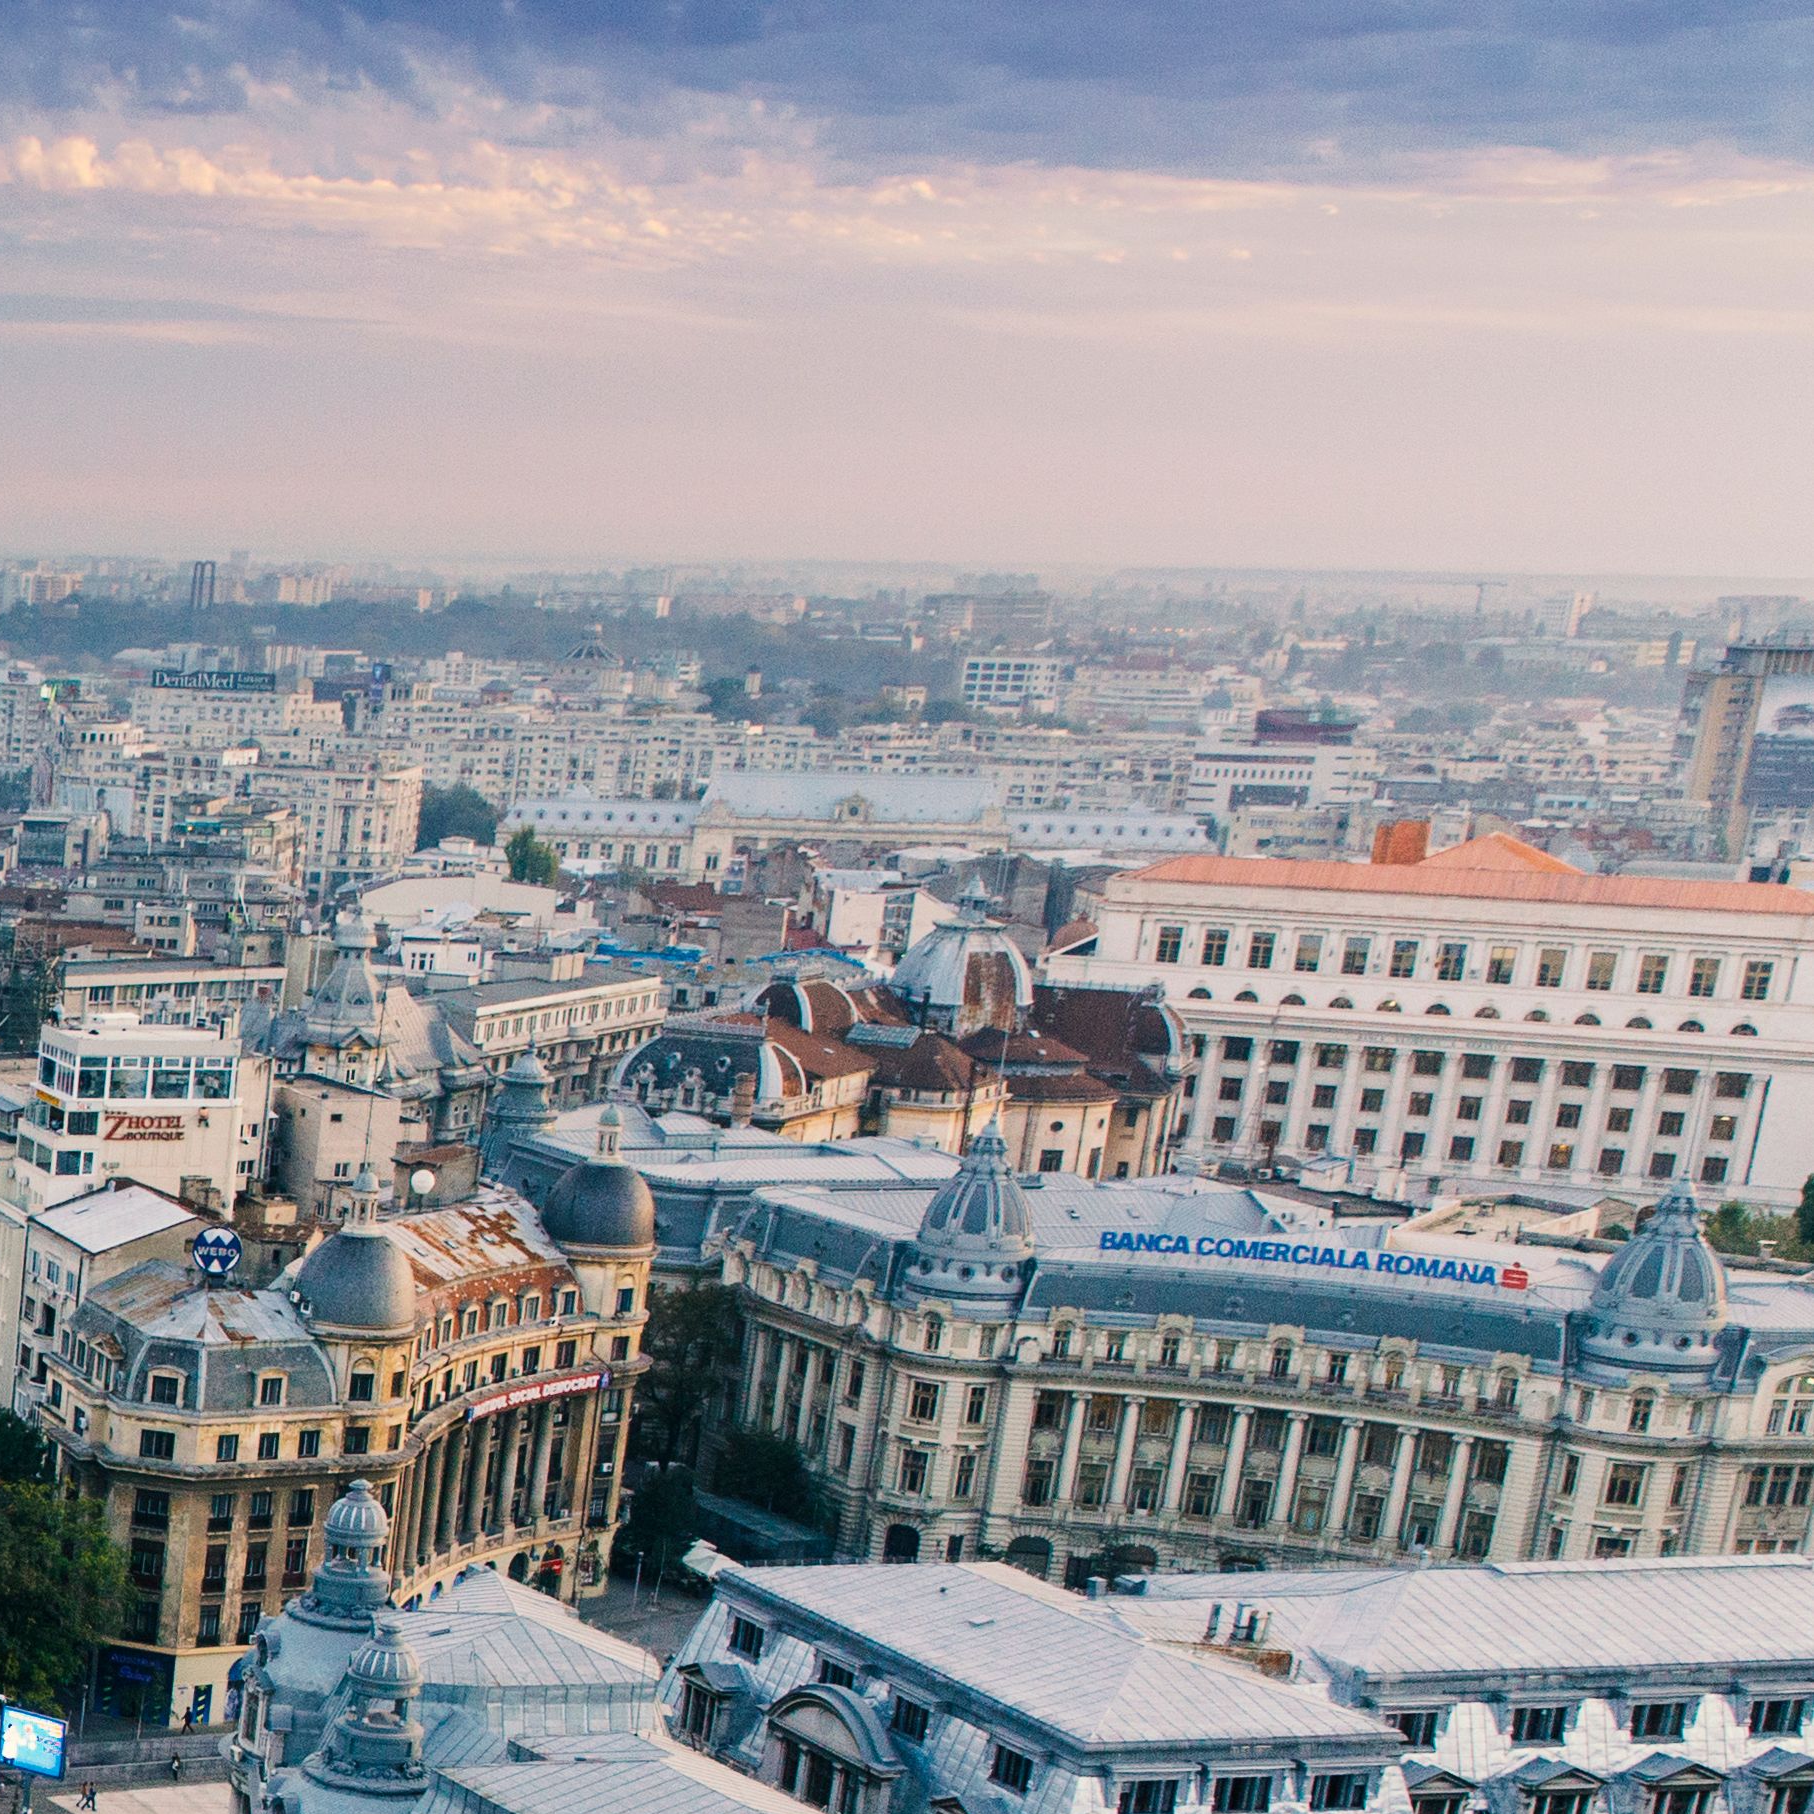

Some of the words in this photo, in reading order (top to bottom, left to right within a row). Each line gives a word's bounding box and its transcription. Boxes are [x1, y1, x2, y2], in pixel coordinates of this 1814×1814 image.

[156, 671, 233, 688] DentalMed
[127, 1116, 185, 1129] HOTEL
[126, 1131, 184, 1141] BOUTIQUE
[1100, 1231, 1189, 1255] BANCA
[1197, 1237, 1370, 1270] COMERCIALA
[1376, 1253, 1496, 1286] ROMANA
[508, 1387, 541, 1405] SOCIAL
[542, 1375, 600, 1396] DEMOCRAT
